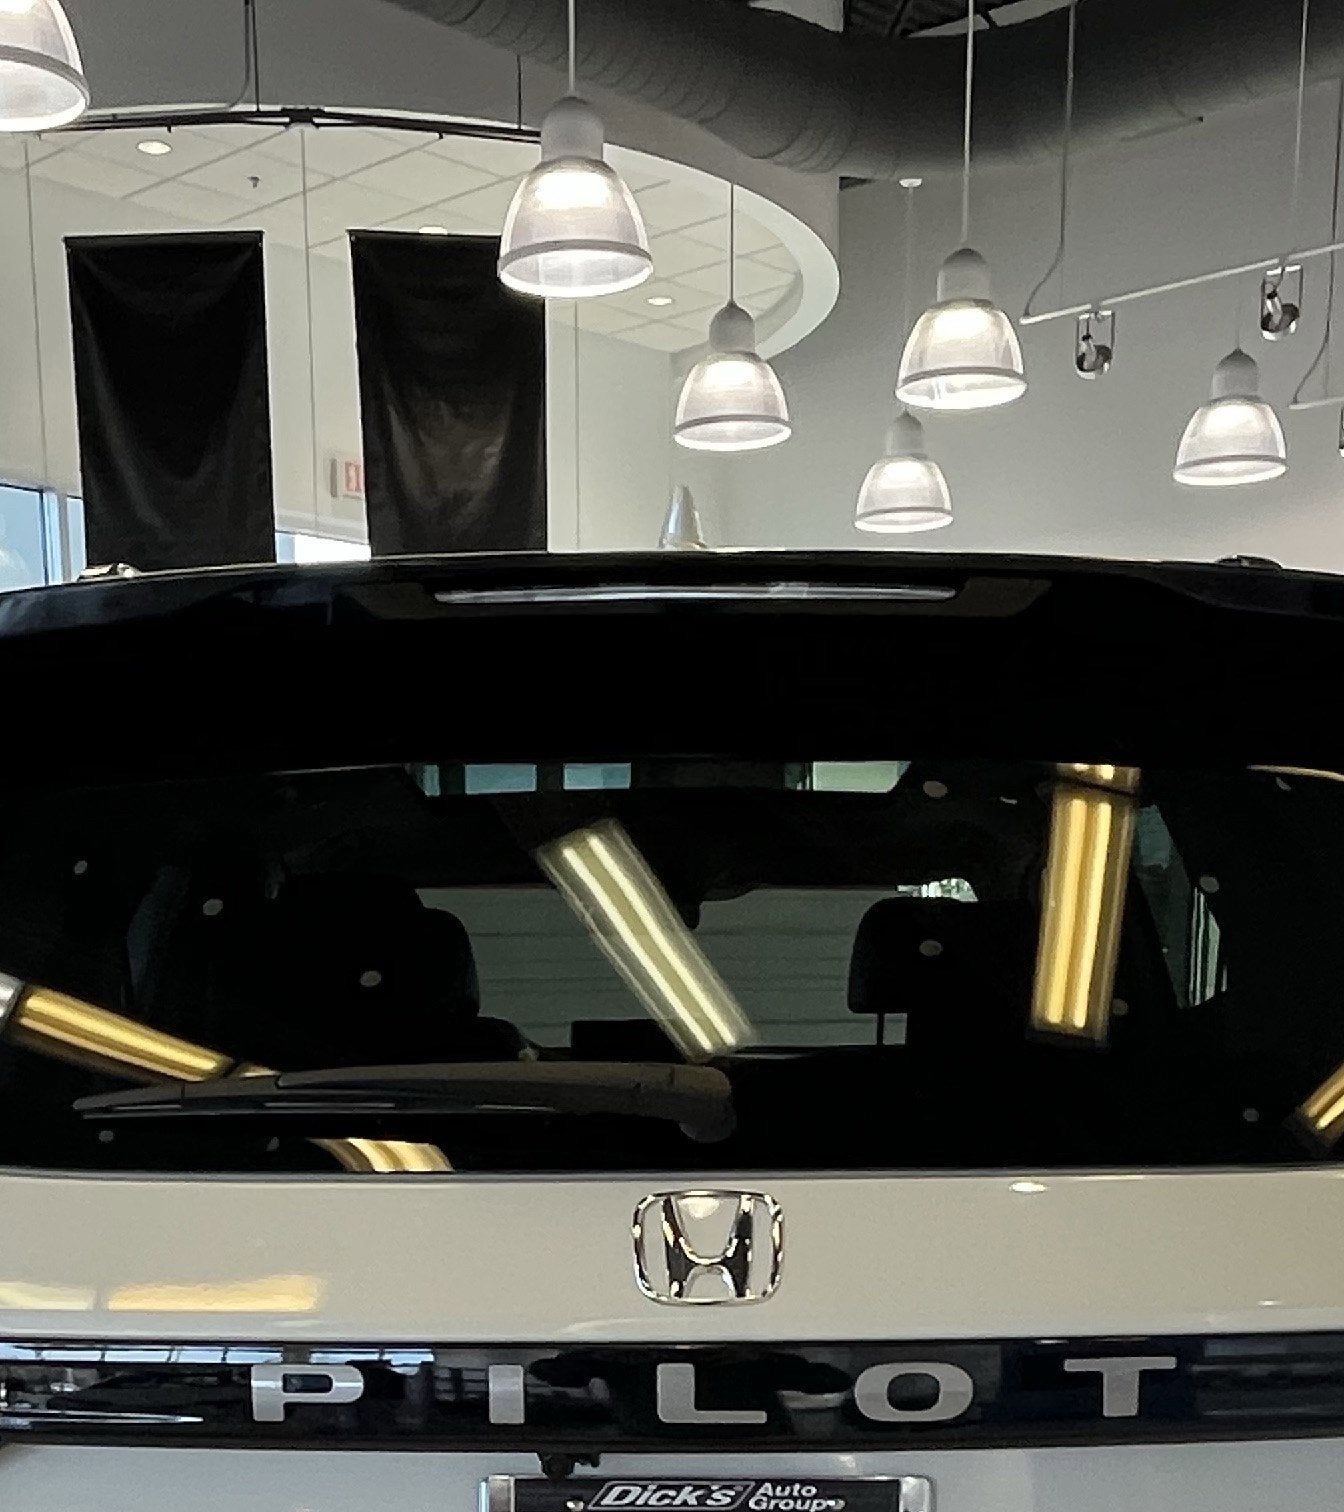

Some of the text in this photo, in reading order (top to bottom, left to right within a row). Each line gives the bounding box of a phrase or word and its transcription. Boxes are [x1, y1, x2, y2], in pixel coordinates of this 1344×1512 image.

[250, 1355, 1177, 1424] PILOT
[601, 1484, 737, 1507] Dick's
[755, 1481, 818, 1498] Auto
